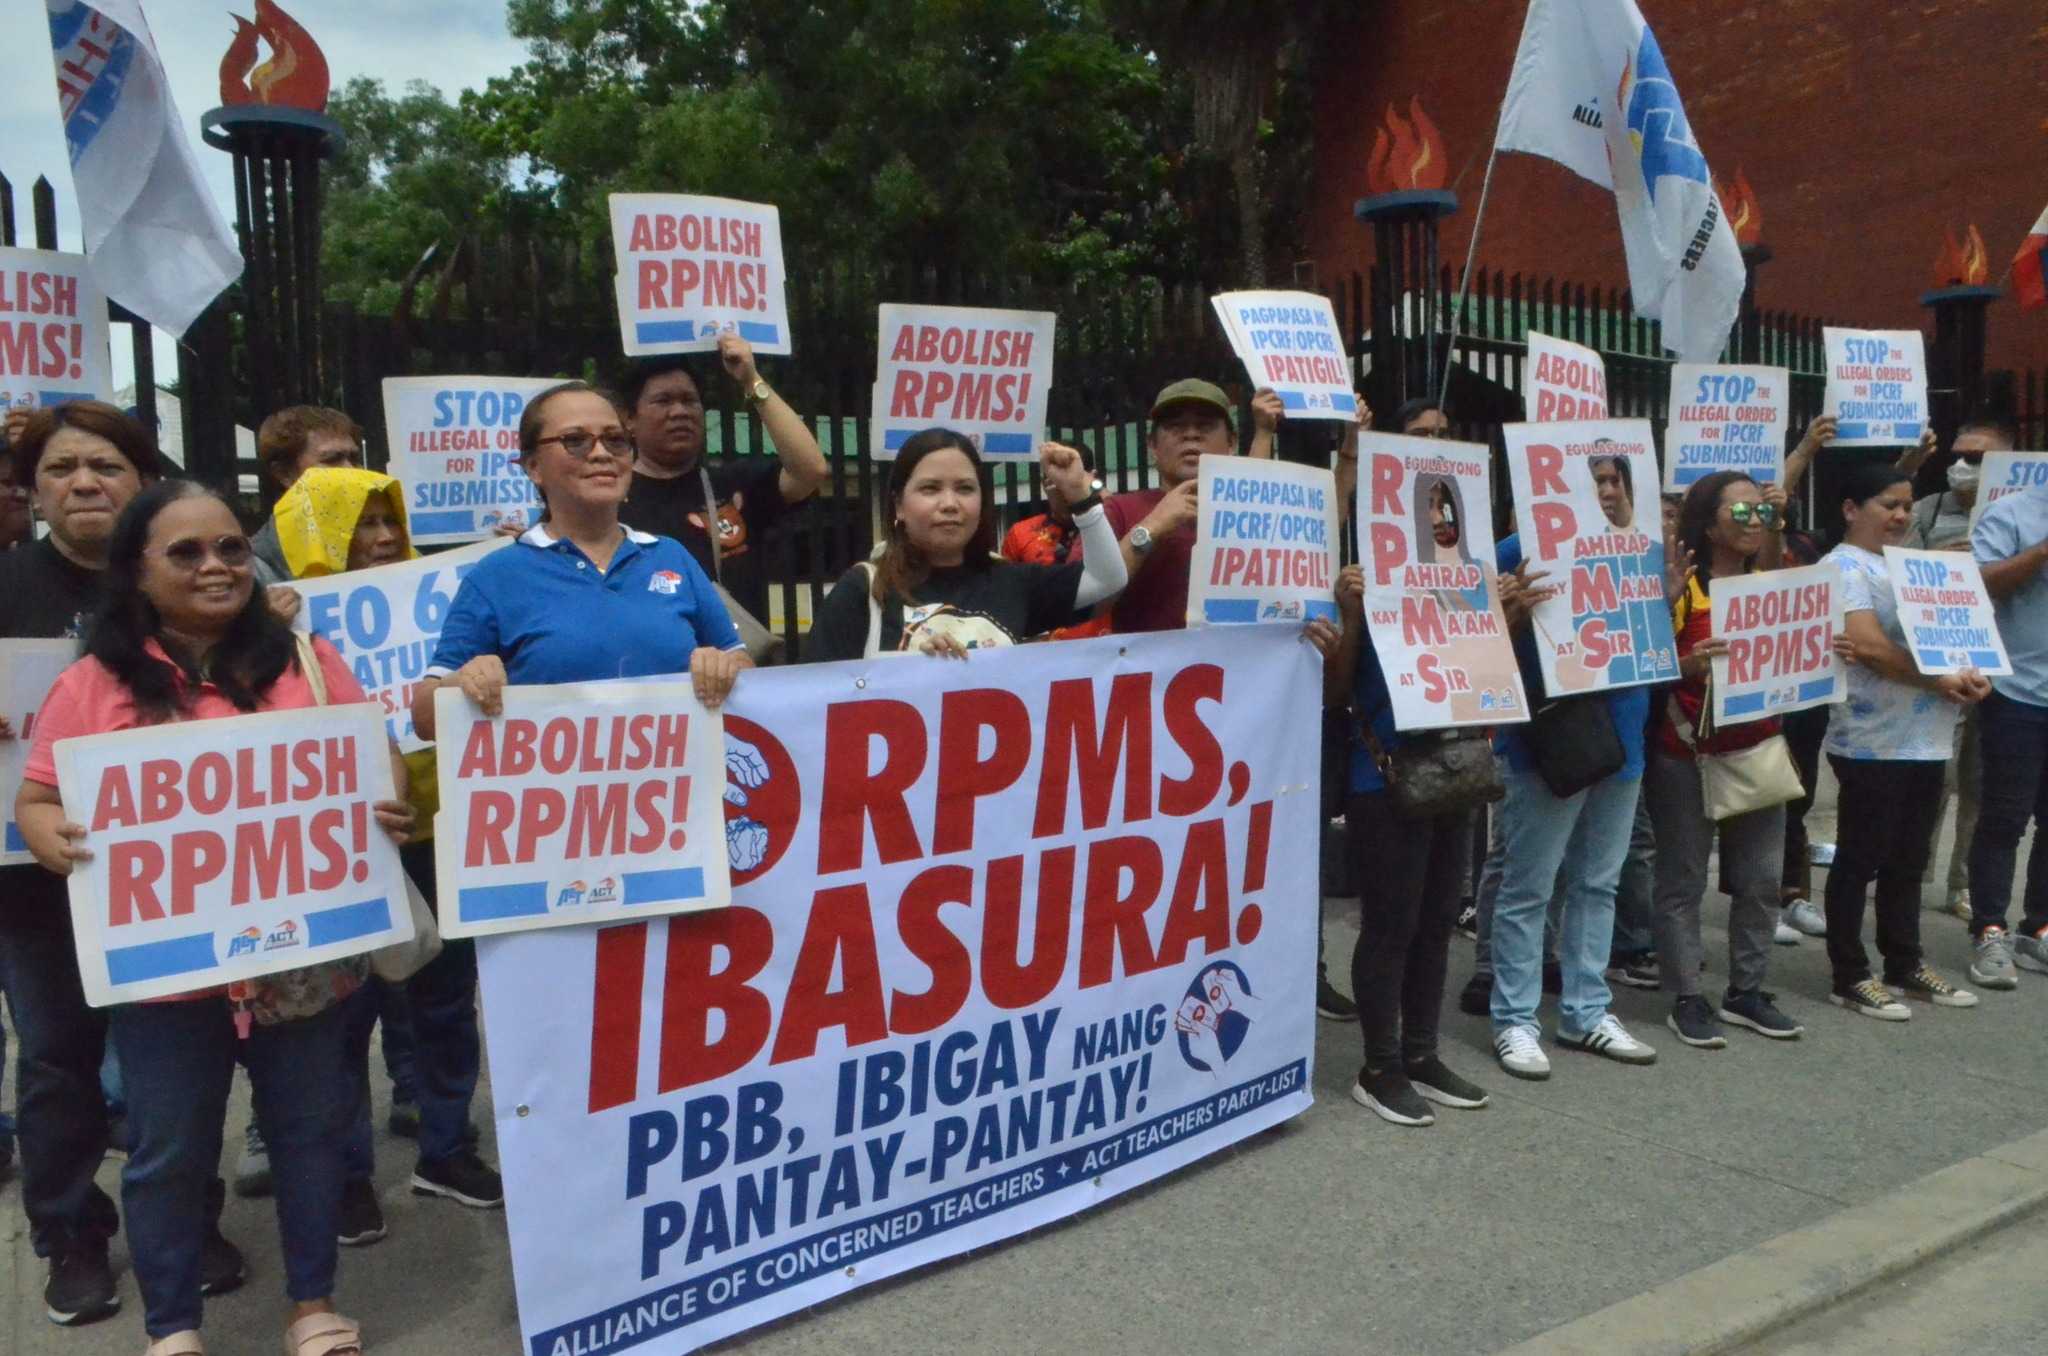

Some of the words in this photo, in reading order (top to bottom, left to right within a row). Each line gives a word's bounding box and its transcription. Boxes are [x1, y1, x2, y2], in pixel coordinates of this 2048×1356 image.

[629, 214, 761, 257] ABOLISH
[638, 259, 767, 312] RPMS!
[1240, 308, 1312, 325] PAGPAPASA
[891, 325, 1034, 367] ABOLISH
[1844, 338, 1888, 364] STOP
[1262, 355, 1345, 385] IPATIGIL!
[1696, 375, 1755, 403] STOP
[1836, 366, 1872, 380] ILLEGAL
[1876, 367, 1912, 381] ORDERS
[433, 390, 523, 427] STOP
[890, 369, 1032, 422] RPMS!
[1838, 401, 1917, 420] SUBMISSION!
[1870, 383, 1903, 400] IPCRF
[1680, 405, 1730, 421] ILLEGAL
[1735, 406, 1777, 422] ORDERS
[1700, 427, 1720, 438] FOR
[1723, 423, 1765, 442] IPCRF
[410, 430, 489, 452] ILLEGAL
[1679, 444, 1776, 464] SUBMISSION!
[446, 459, 474, 473] FOR
[481, 452, 524, 477] IPC
[415, 479, 537, 508] SUBMISSI
[1212, 477, 1304, 507] PAGPAPASA
[1308, 487, 1324, 511] NG
[1212, 510, 1327, 549] IPCRF/OPCRF,
[1531, 502, 1649, 561] PAHIRAP
[1210, 547, 1329, 588] IPATIGIL!
[1371, 522, 1480, 588] PAHIRAP
[1904, 558, 1947, 587] STOP
[1372, 611, 1398, 624] KAY
[1724, 582, 1829, 632] ABOLISH
[1936, 607, 1970, 625] IPCRF
[1938, 590, 1979, 606] ORDERS
[1557, 643, 1574, 656] AT
[1580, 619, 1632, 669] SIR
[1728, 620, 1833, 685] RPMS!
[1914, 627, 1990, 648] SUBMISSION!
[1400, 673, 1414, 686] AT
[1417, 654, 1470, 703] SIR
[457, 714, 690, 778] ABOLISH
[91, 736, 358, 832] ABOLISH
[817, 663, 1250, 875] RPMS,
[464, 776, 692, 868] RPMS!
[108, 801, 370, 927] RPMS!
[588, 800, 1272, 1115] IBASURA!
[626, 1080, 804, 1200] PBB,
[834, 1007, 1062, 1138] IBIGAY
[1073, 1003, 1167, 1070] NANG
[641, 1053, 1152, 1281] PANTAY-PANTAY!
[550, 1287, 697, 1356] ALLIANCE
[707, 1270, 747, 1304] OF
[756, 1210, 923, 1286] CONCERNED
[929, 1167, 1044, 1226] TEACHERS
[1081, 1144, 1123, 1174] ACT
[1127, 1106, 1214, 1155] TEACHERS
[1217, 1066, 1299, 1122] PARTY-LIST
